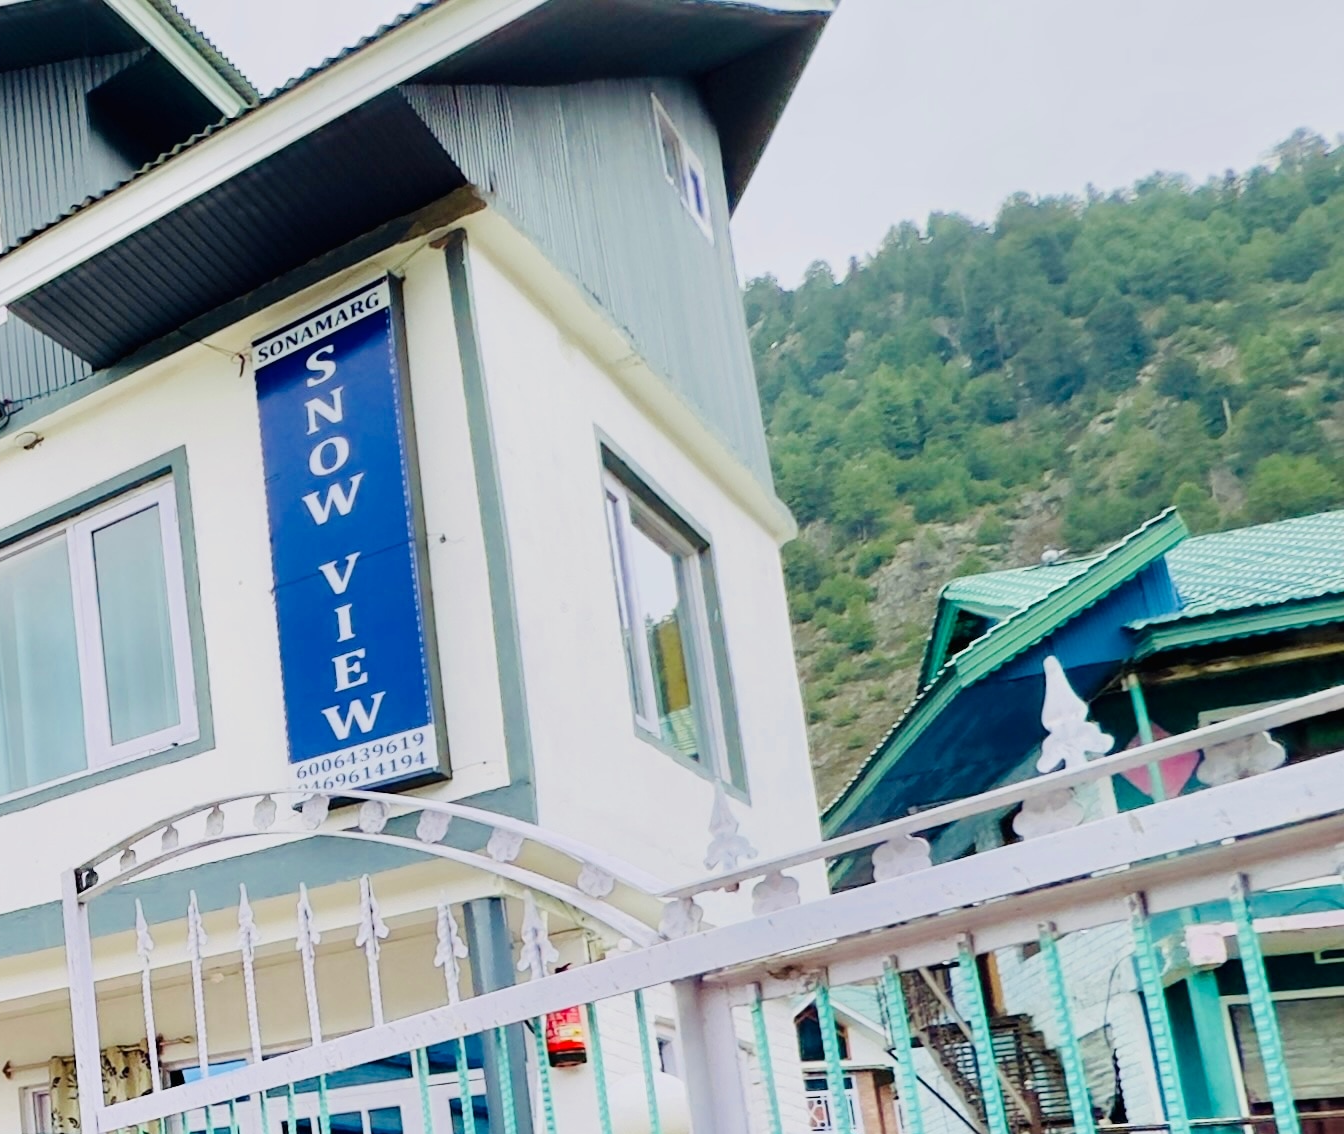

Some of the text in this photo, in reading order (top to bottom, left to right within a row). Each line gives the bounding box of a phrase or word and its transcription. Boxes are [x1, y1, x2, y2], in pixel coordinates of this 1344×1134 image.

[258, 291, 380, 363] SONAMARG
[301, 344, 387, 742] SNOW VIEW
[296, 732, 425, 779] 6006439619
